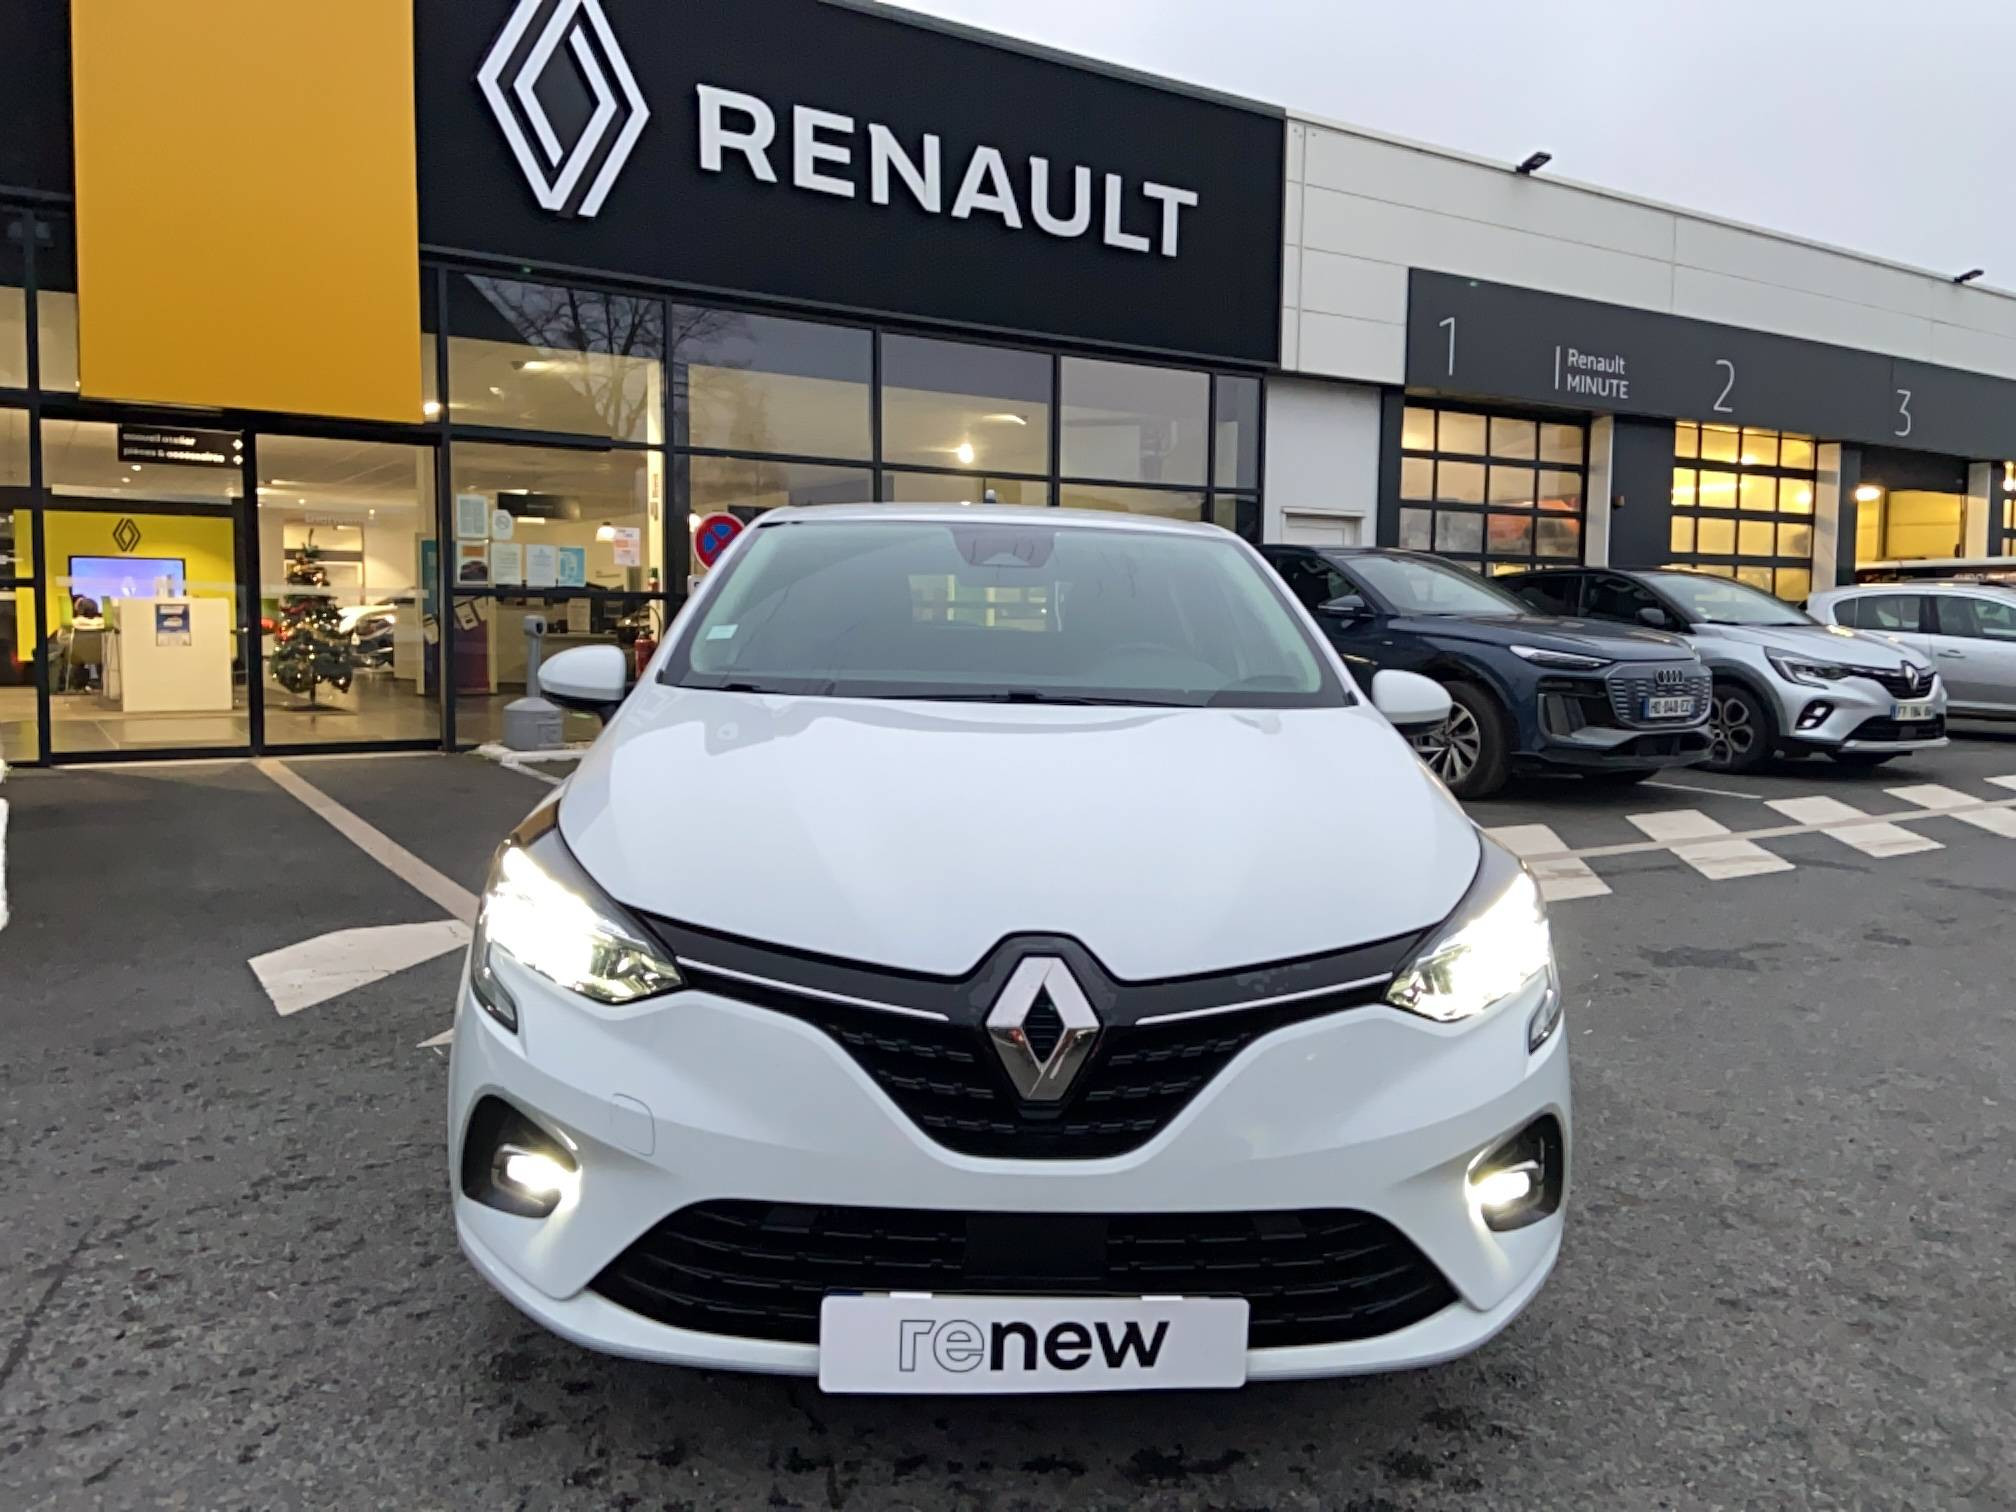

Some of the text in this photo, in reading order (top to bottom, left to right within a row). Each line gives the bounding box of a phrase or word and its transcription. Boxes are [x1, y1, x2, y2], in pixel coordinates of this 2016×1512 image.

[696, 83, 1198, 257] RENAULT
[1439, 317, 1455, 376] 1
[1567, 347, 1625, 375] Renault
[1567, 373, 1629, 399] MINUTE
[1713, 359, 1735, 412] 2
[1894, 389, 1911, 437] 3
[900, 1319, 1170, 1373] renew
